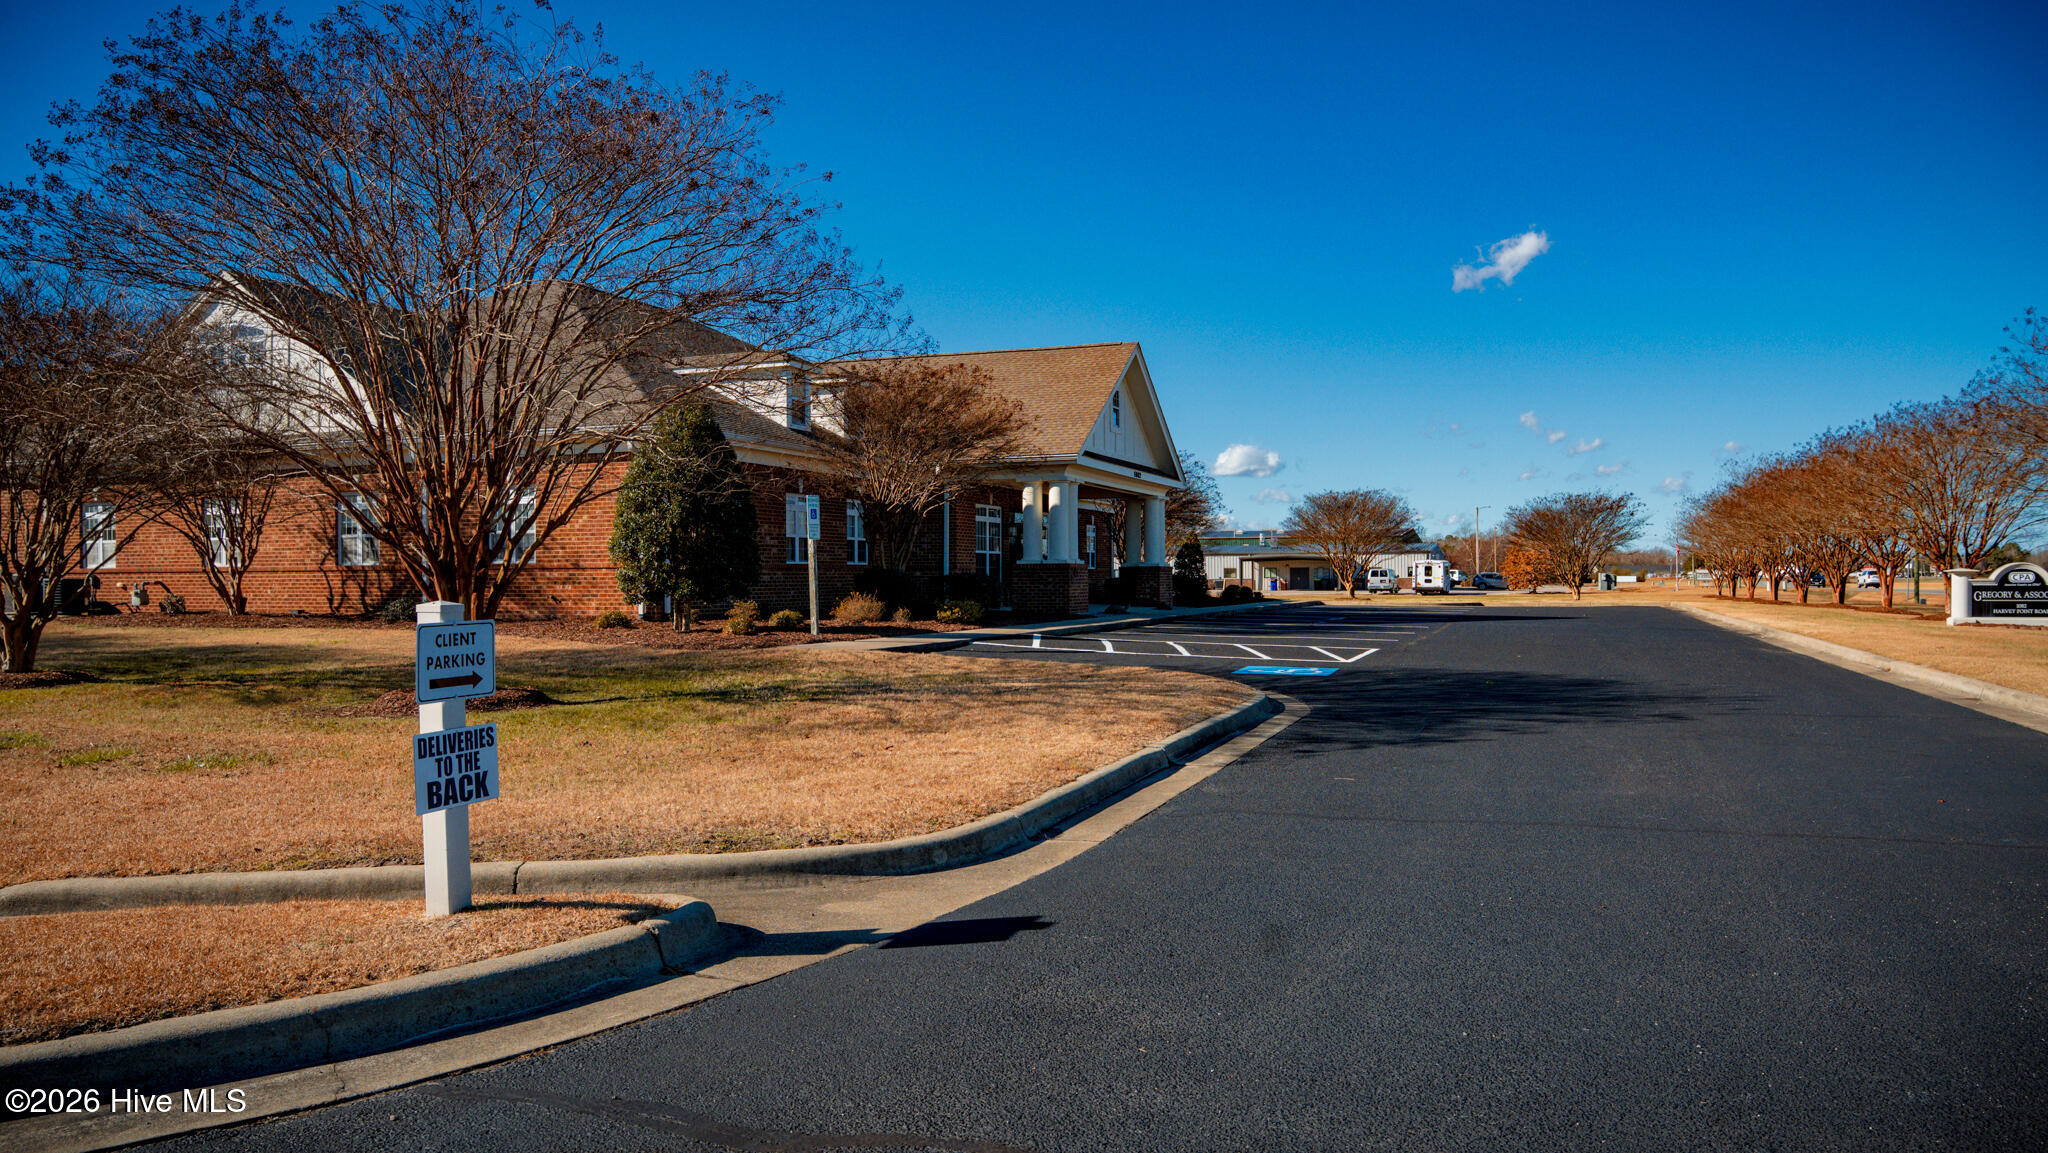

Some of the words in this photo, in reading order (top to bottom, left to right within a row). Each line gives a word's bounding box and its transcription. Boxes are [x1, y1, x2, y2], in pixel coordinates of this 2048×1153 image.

[1973, 591, 2013, 601] GREGORY
[2014, 591, 2022, 599] &
[435, 632, 476, 648] CLIENT
[426, 652, 486, 671] PARKING
[417, 726, 495, 759] DELIVERIES
[435, 755, 453, 778] TO
[456, 750, 480, 774] THE
[427, 770, 490, 810] BACK
